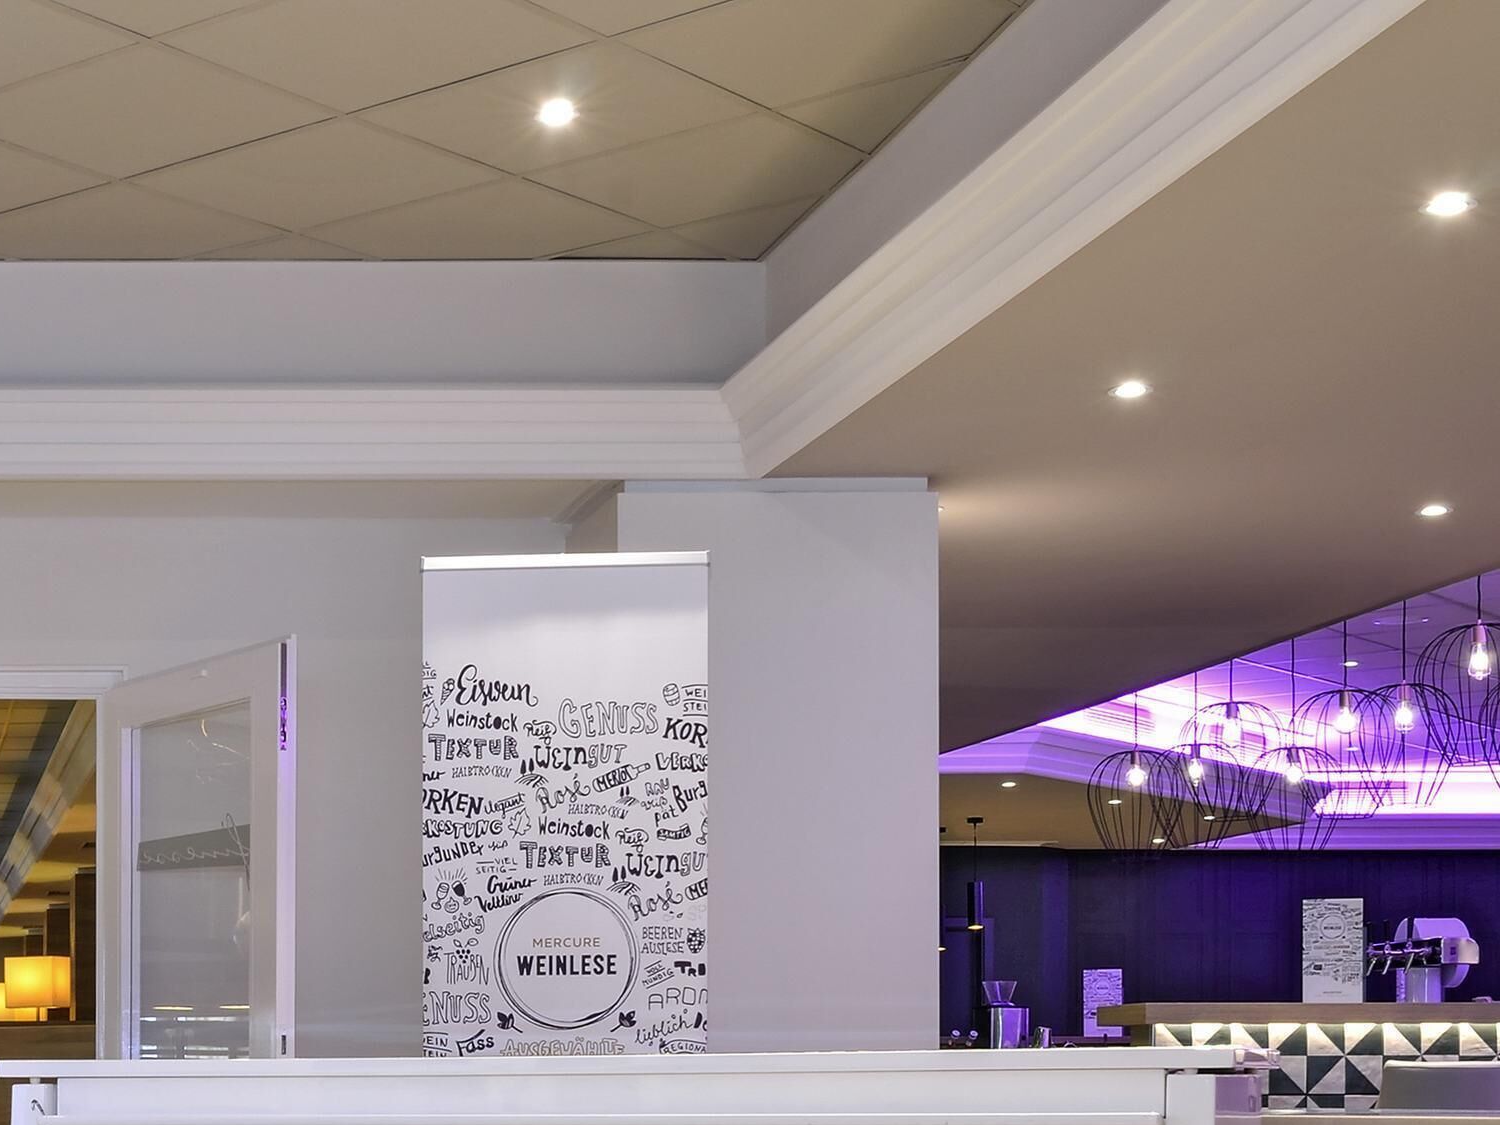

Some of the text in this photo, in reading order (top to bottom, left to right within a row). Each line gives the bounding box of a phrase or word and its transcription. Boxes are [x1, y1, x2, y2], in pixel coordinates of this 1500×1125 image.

[455, 664, 539, 707] Eiswein
[447, 708, 518, 732] Weinstock
[558, 698, 659, 739] GENUSS
[662, 717, 708, 749] KOR
[428, 733, 519, 761] TEXTUR
[539, 816, 610, 840] Weinstock
[519, 841, 611, 869] TEXTUR
[532, 937, 601, 948] MERCURE
[642, 926, 684, 940] BEEREN
[641, 941, 685, 956] AUSLESE
[443, 952, 489, 986] TRAUBEN
[517, 954, 617, 976] WEINLESE
[422, 1036, 449, 1047] EIN
